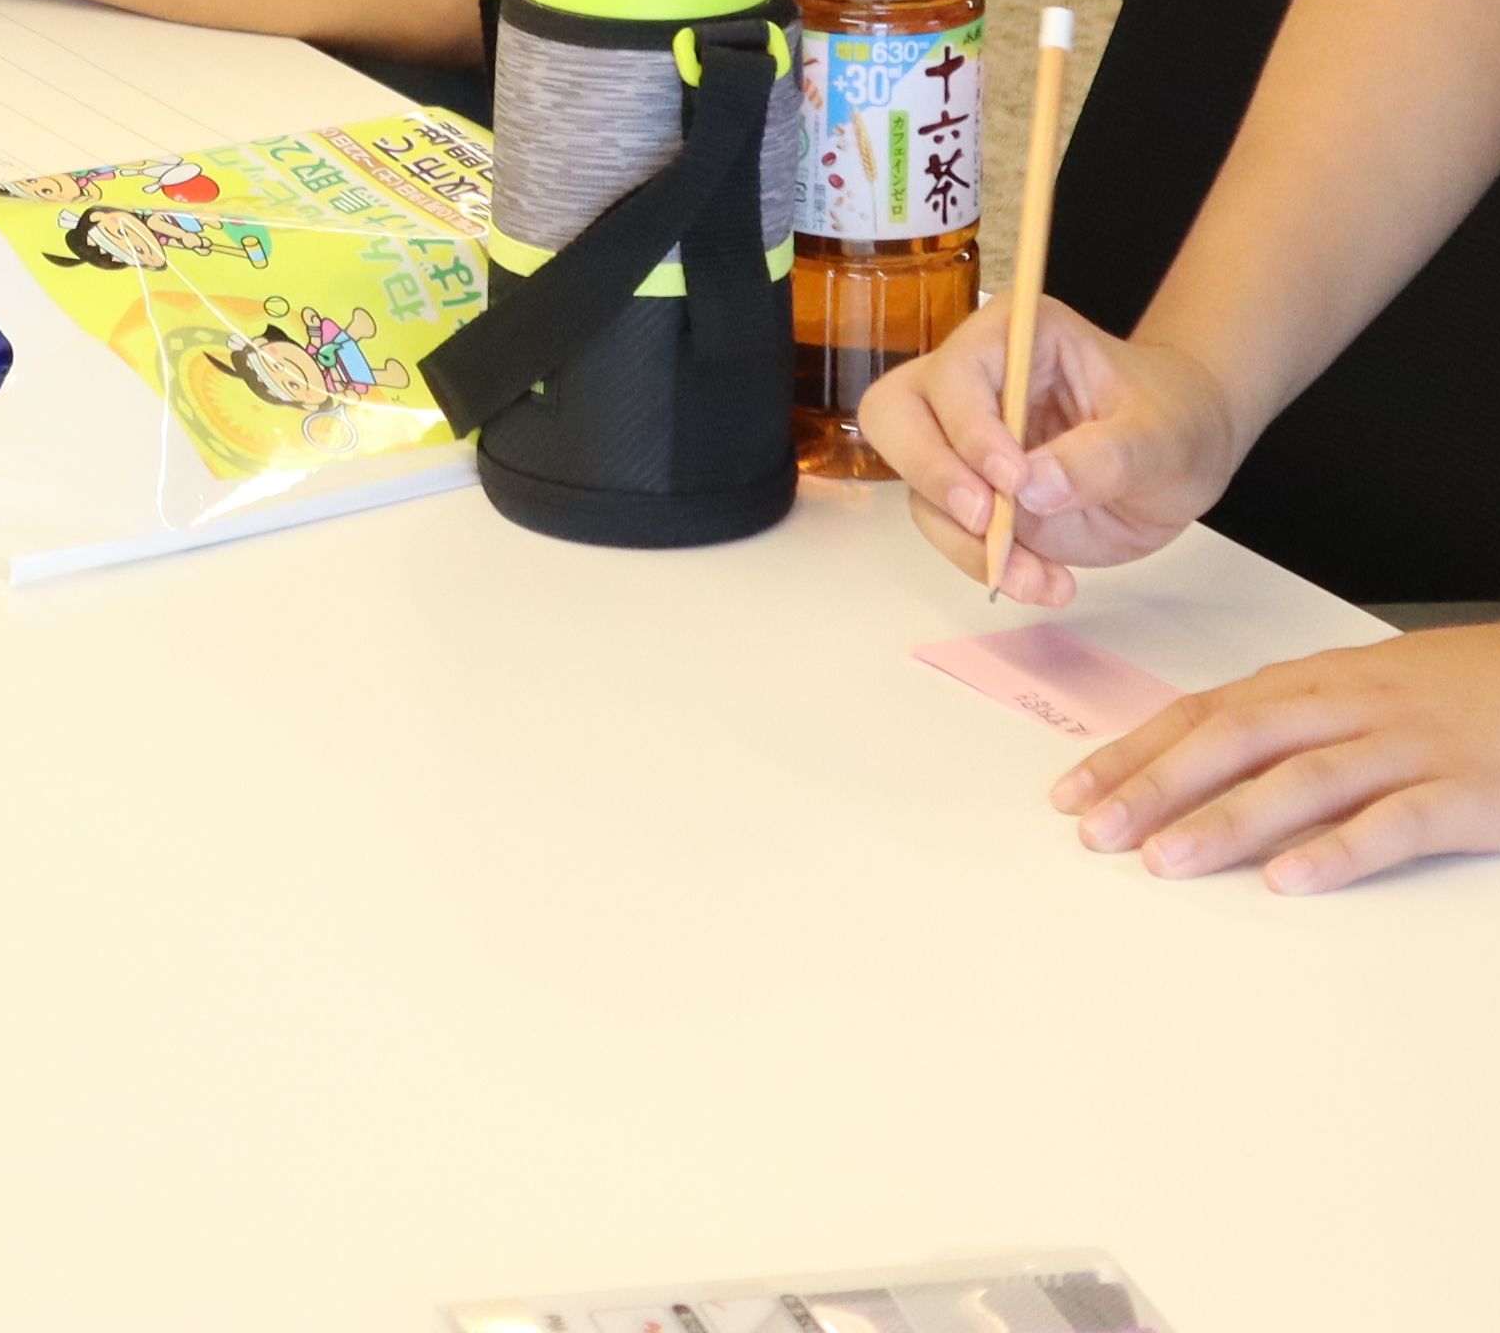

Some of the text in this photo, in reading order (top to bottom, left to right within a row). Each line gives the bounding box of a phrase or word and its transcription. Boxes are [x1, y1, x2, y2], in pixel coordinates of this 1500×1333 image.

[890, 115, 906, 217] カフェインゼロ
[917, 44, 971, 227] 十六茶
